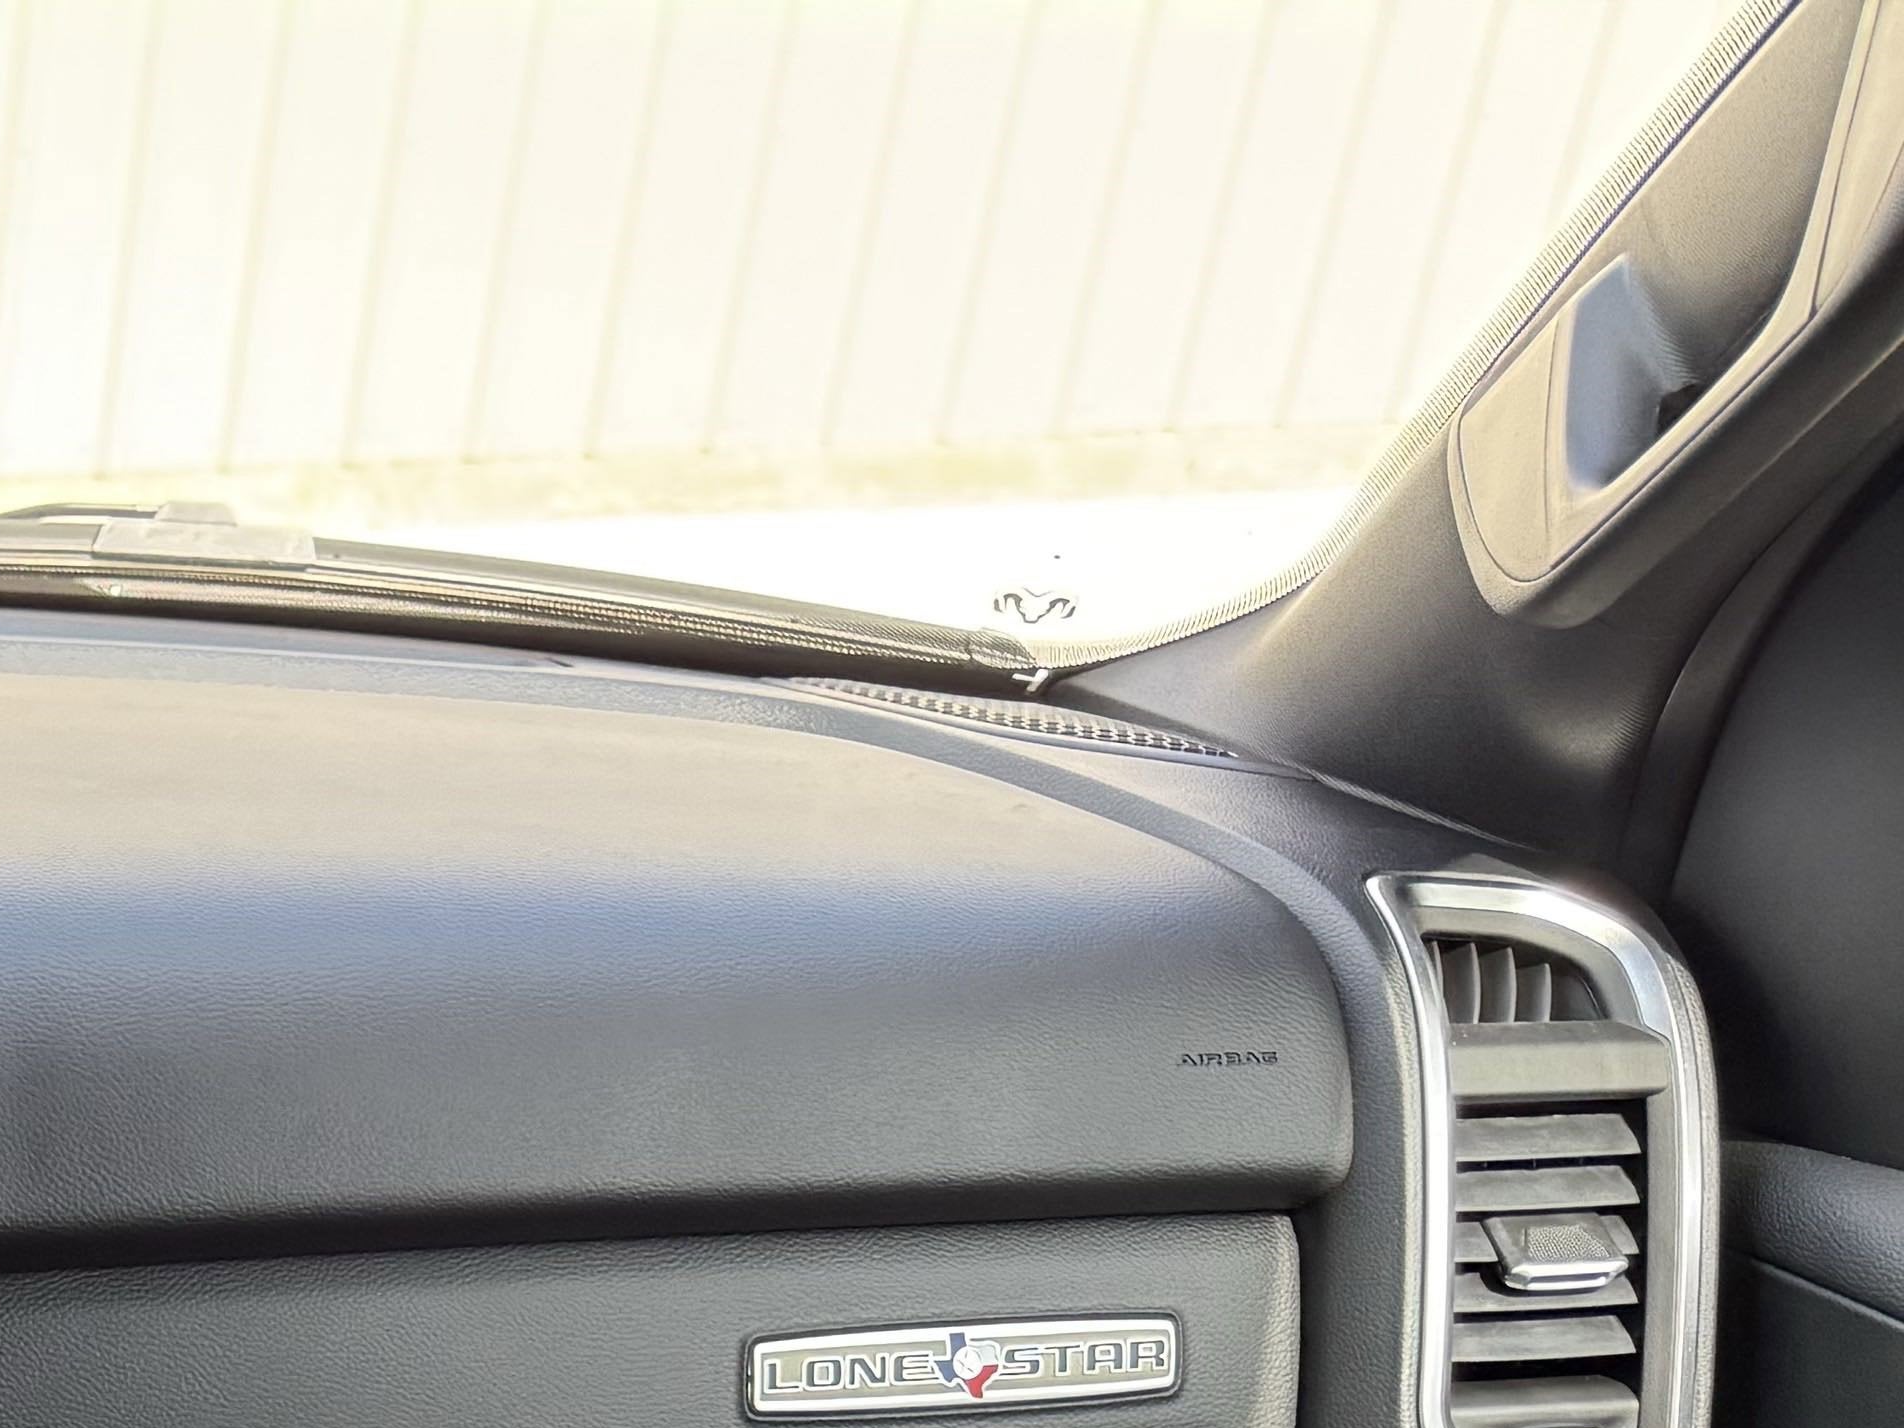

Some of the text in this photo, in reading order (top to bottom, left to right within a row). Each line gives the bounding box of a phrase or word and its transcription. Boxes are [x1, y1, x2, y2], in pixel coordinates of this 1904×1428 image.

[1176, 1050, 1279, 1068] AIRBAG
[762, 1335, 1169, 1397] LONE STAR
